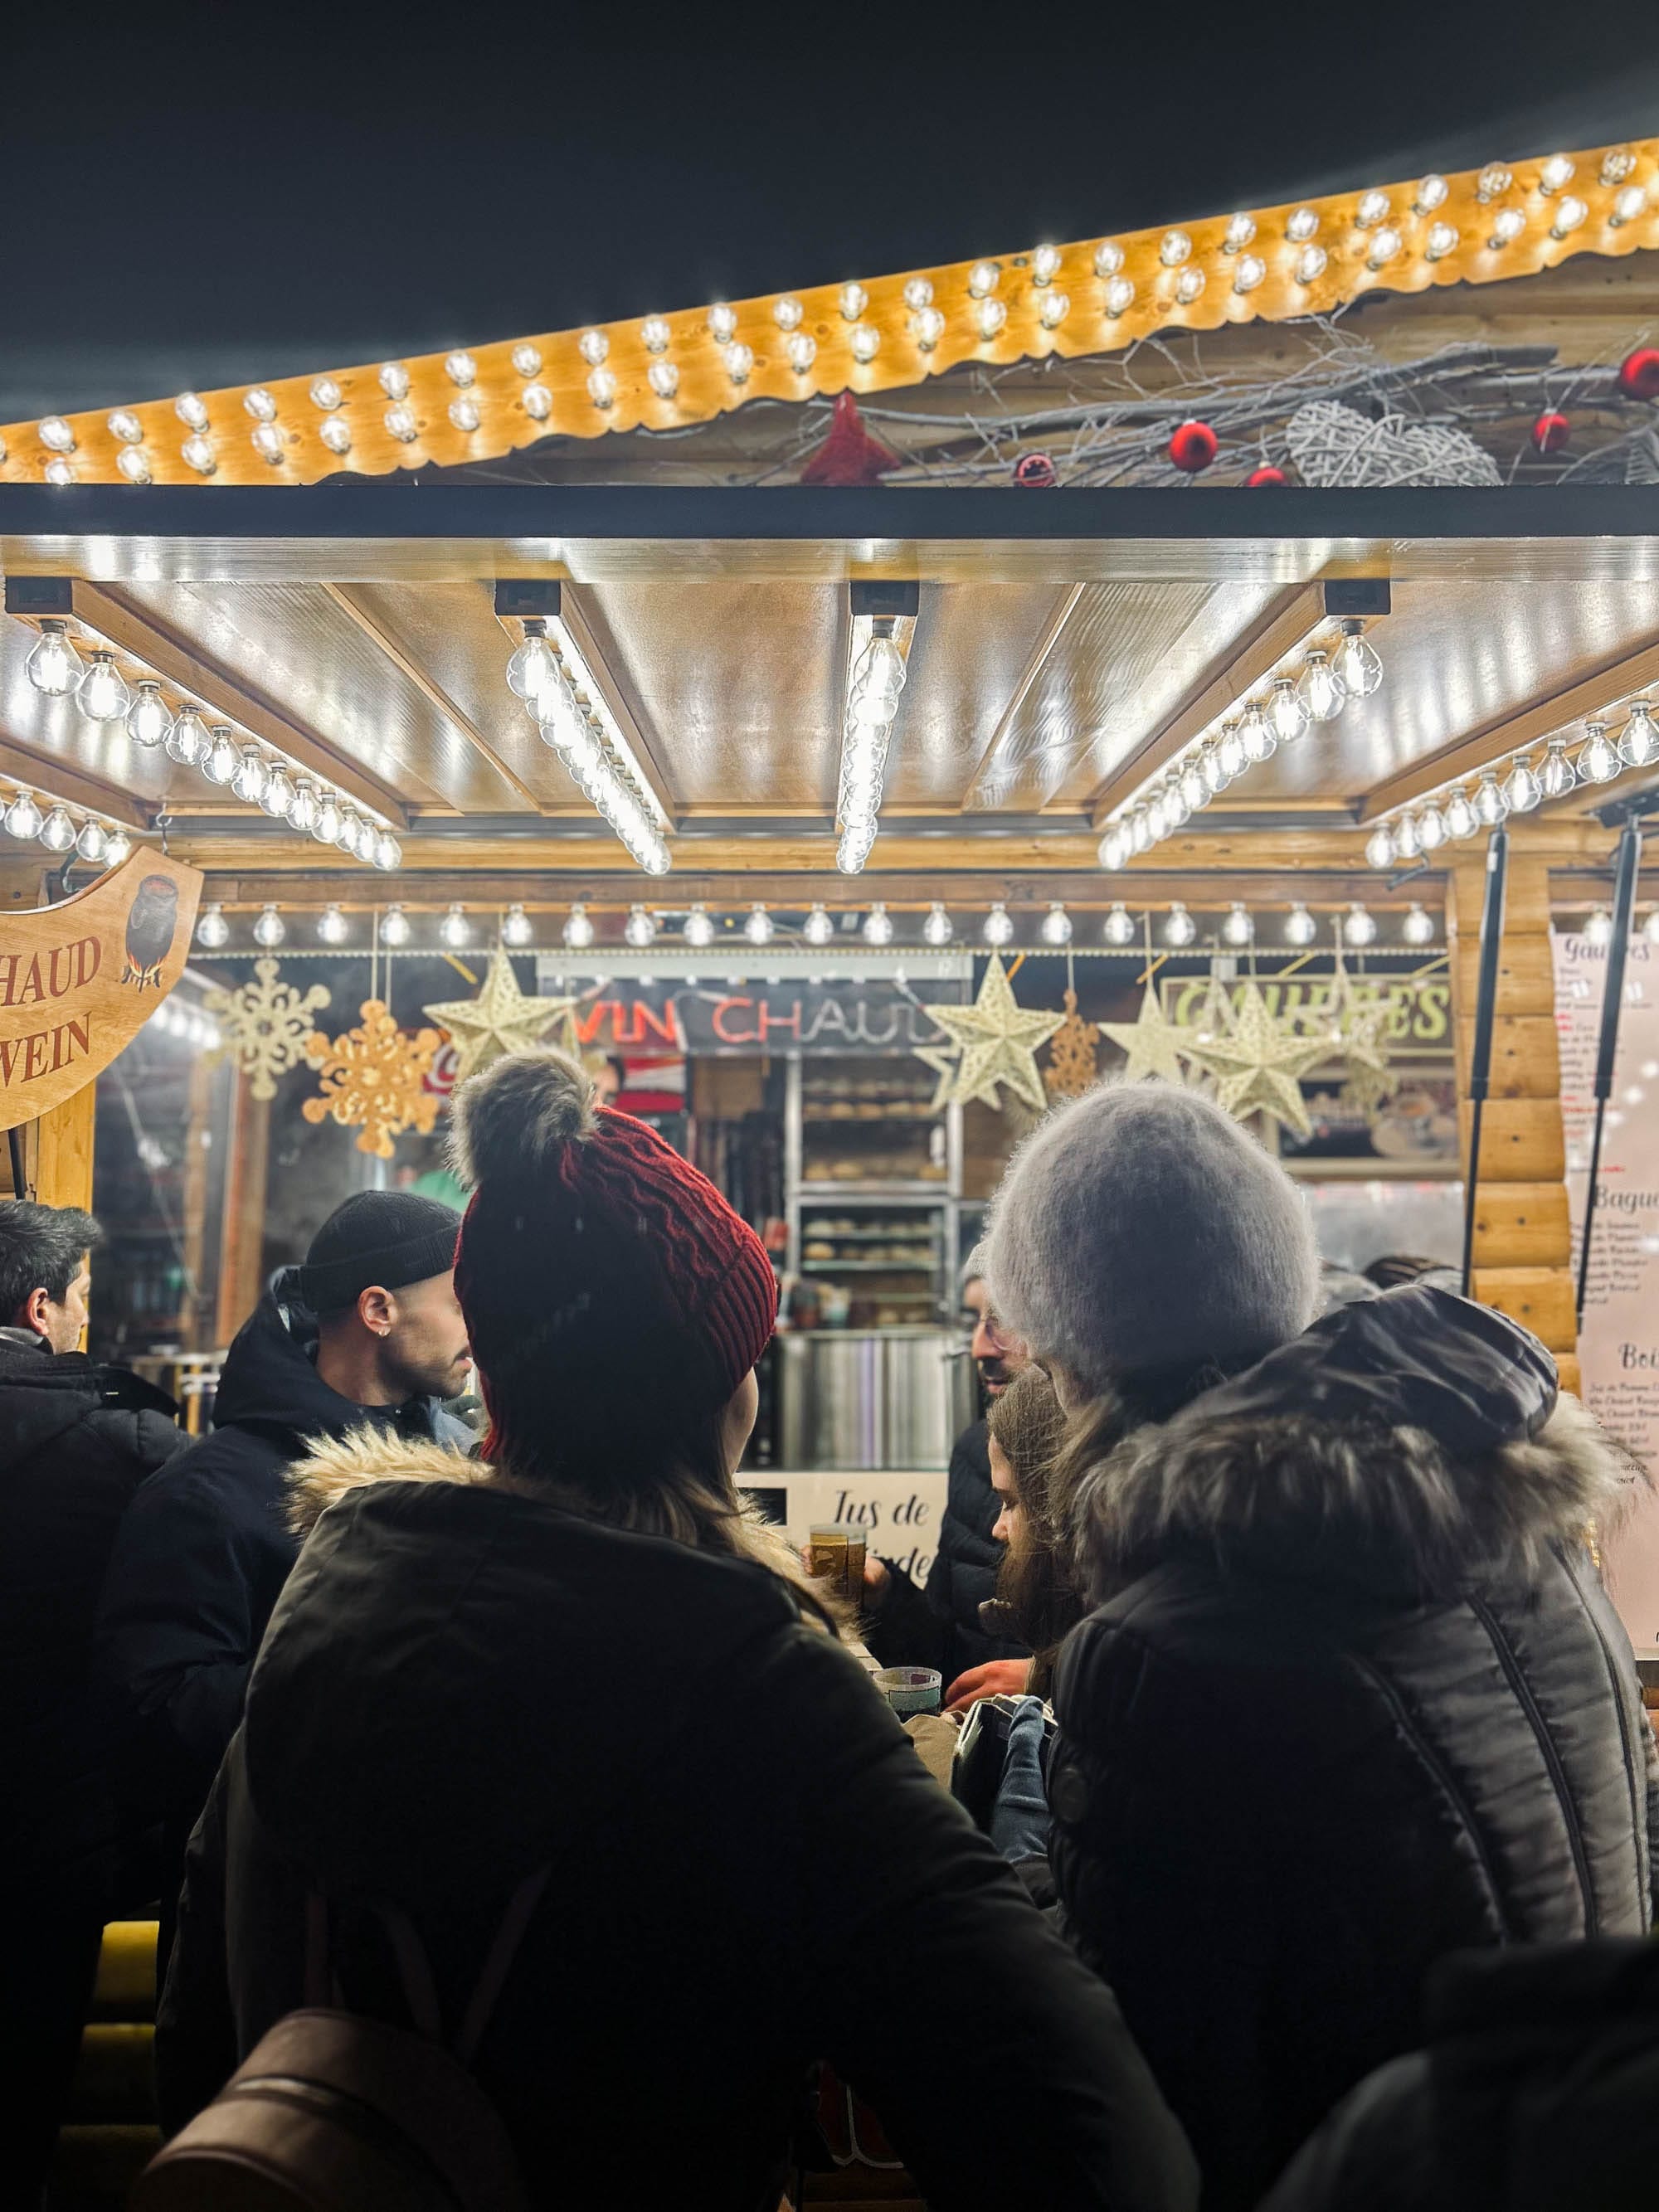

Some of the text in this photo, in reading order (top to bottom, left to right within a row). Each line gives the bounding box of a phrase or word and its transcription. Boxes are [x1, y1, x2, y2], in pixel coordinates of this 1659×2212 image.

[1564, 937, 1651, 963] Gaues
[574, 1000, 676, 1043] VIN
[893, 1494, 929, 1527] de
